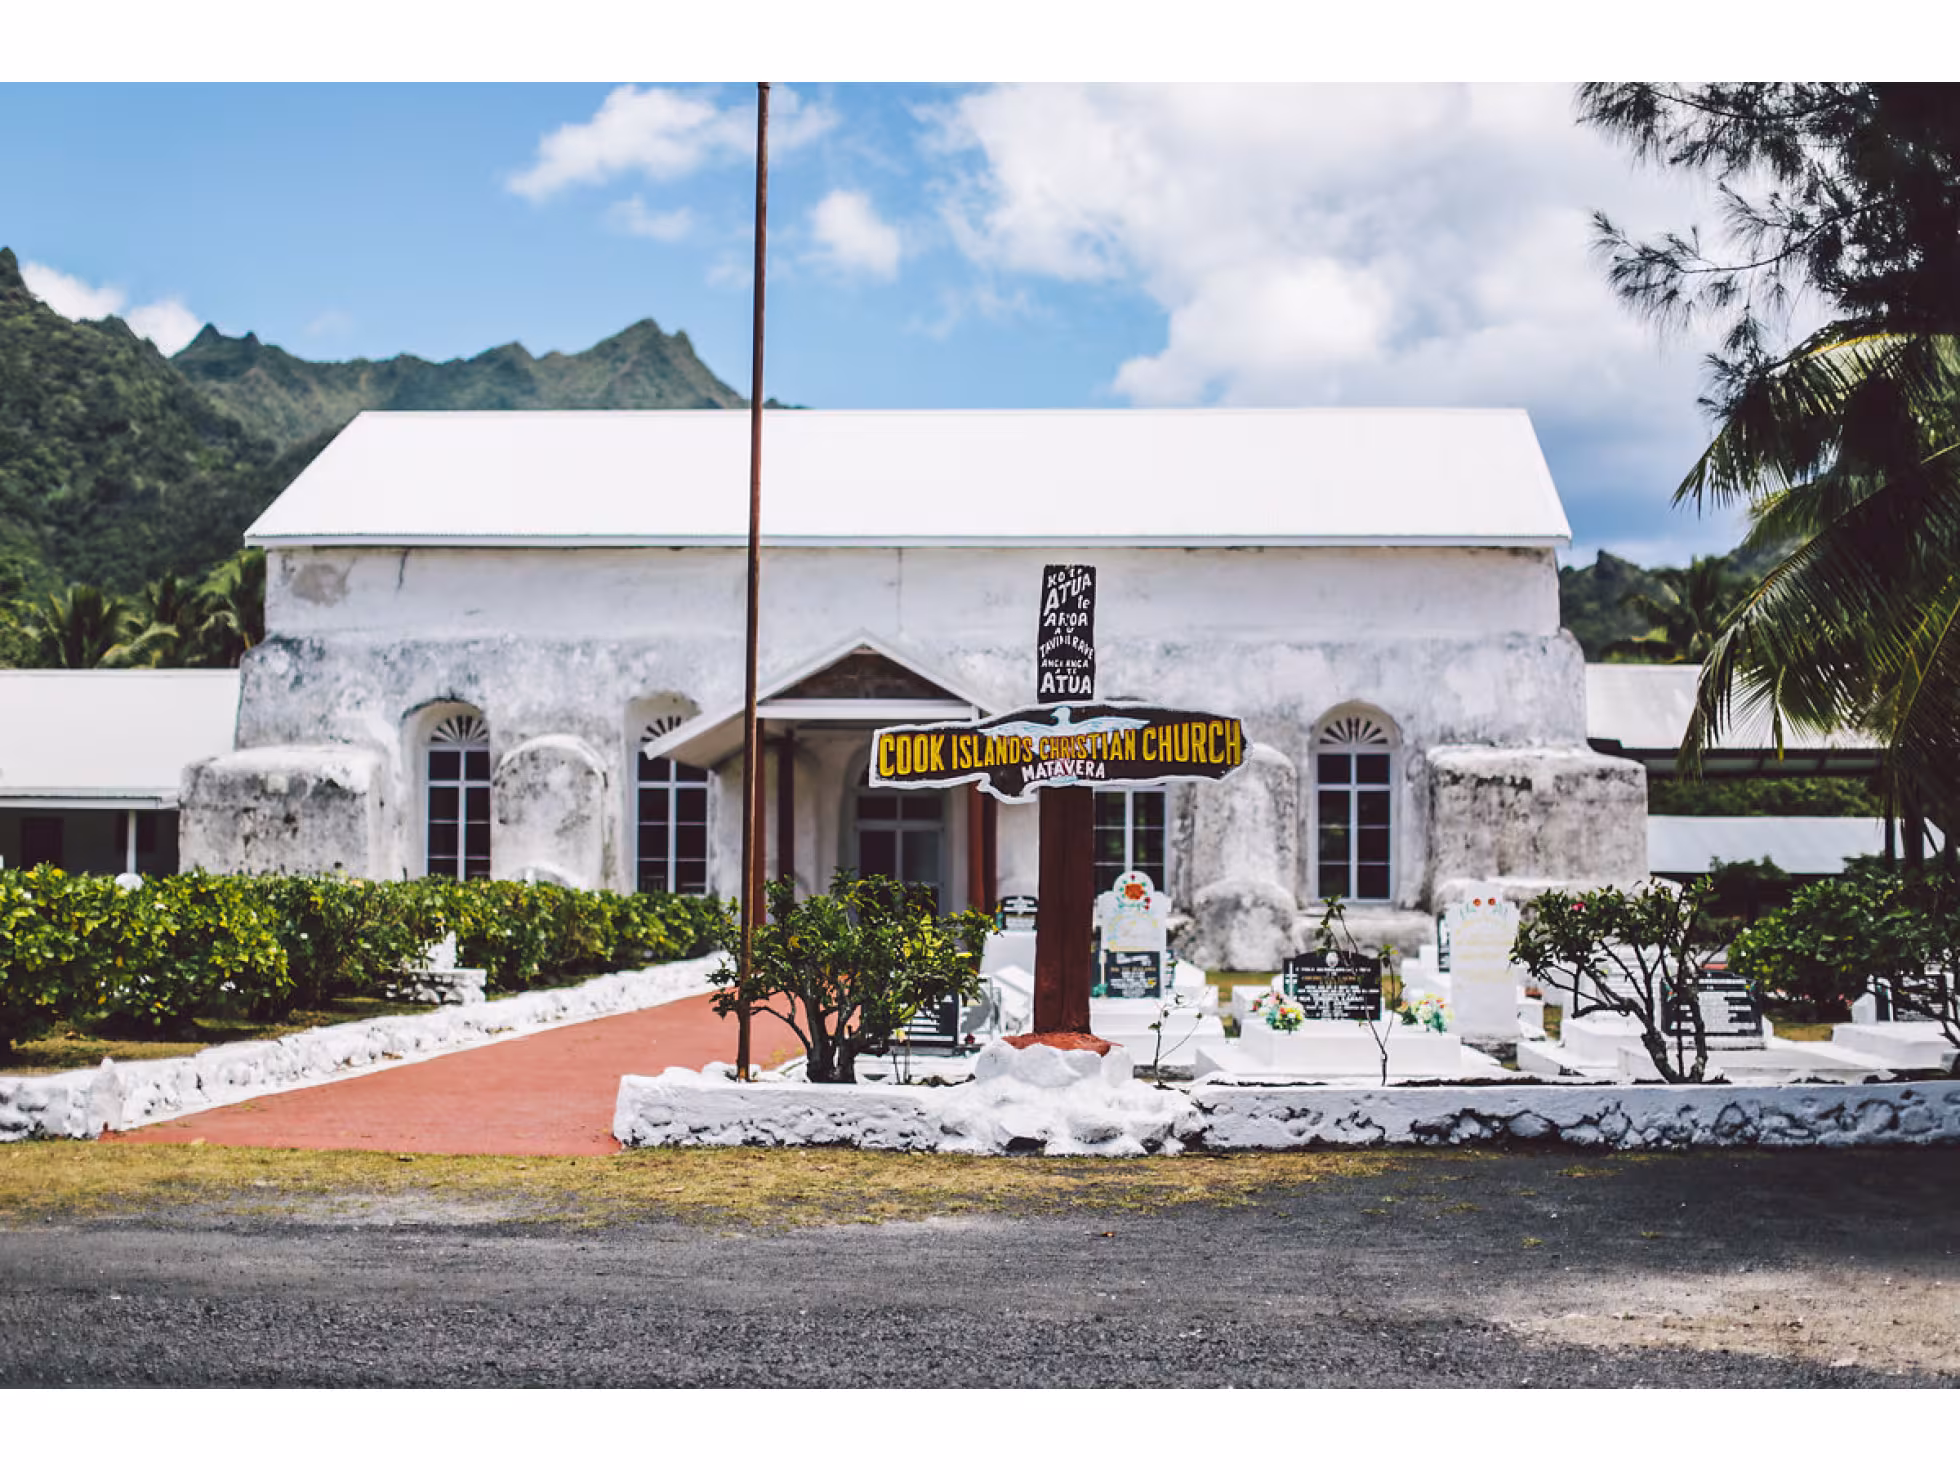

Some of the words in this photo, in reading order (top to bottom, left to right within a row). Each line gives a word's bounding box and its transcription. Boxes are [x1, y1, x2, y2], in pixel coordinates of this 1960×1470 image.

[1043, 573, 1092, 617] ATUA
[1040, 671, 1092, 694] ATUA
[879, 733, 945, 777] COOK
[951, 733, 1033, 770] ISLANDS
[1039, 728, 1136, 761] CHRISTIAN
[1142, 719, 1242, 767] CHURCH
[1022, 759, 1105, 782] MATAVERA
